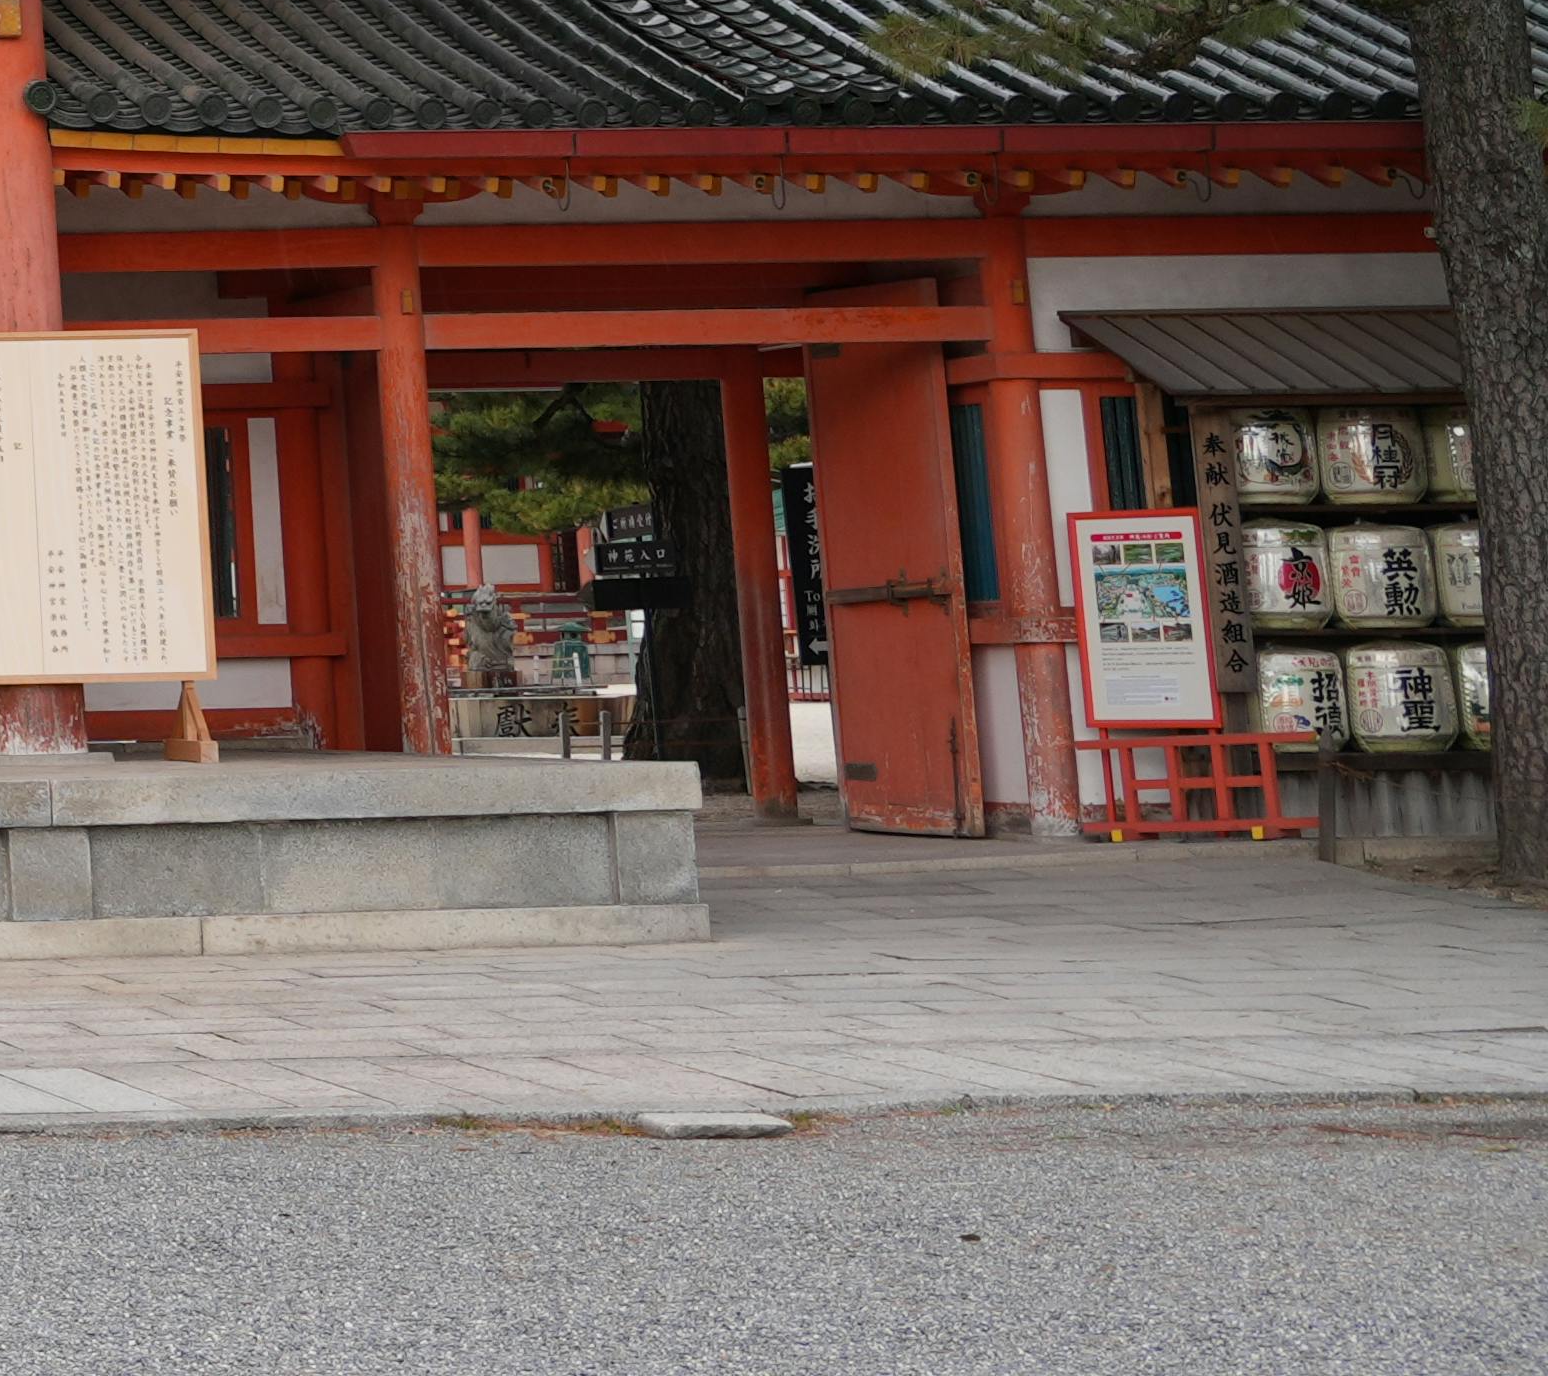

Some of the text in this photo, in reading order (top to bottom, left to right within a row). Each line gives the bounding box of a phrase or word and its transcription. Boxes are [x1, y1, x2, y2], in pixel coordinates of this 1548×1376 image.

[162, 395, 175, 440] 記念事業
[1372, 423, 1401, 489] 月桂冠
[607, 547, 667, 563] 神苑入口
[1201, 431, 1249, 674] 奉献 伏見酒造組合
[1282, 547, 1320, 610] 京姫
[1382, 548, 1421, 616] 英勲
[1395, 667, 1441, 733] 神聖
